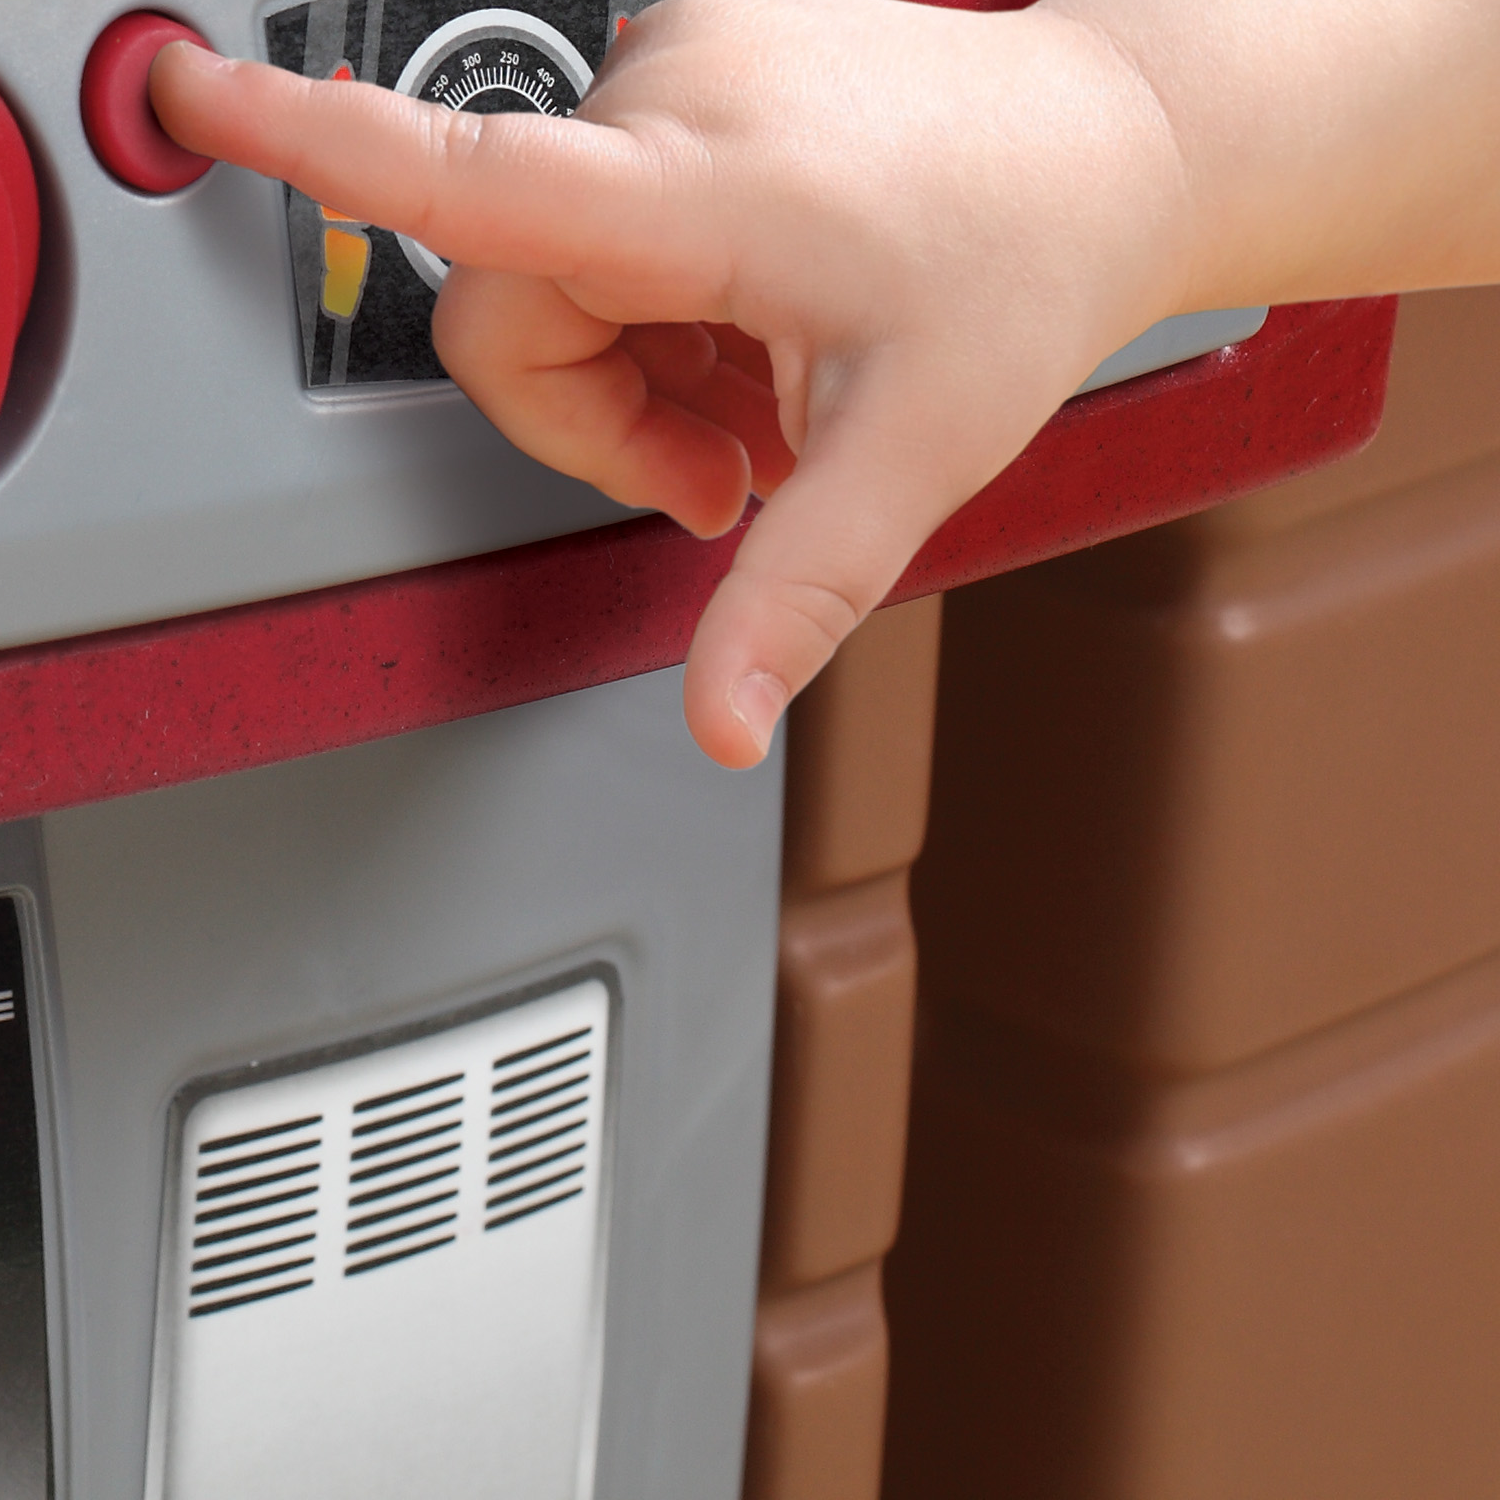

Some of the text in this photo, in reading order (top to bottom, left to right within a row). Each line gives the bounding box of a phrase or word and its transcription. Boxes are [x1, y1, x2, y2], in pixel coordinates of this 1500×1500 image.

[430, 51, 555, 98] 250 300 250 400
